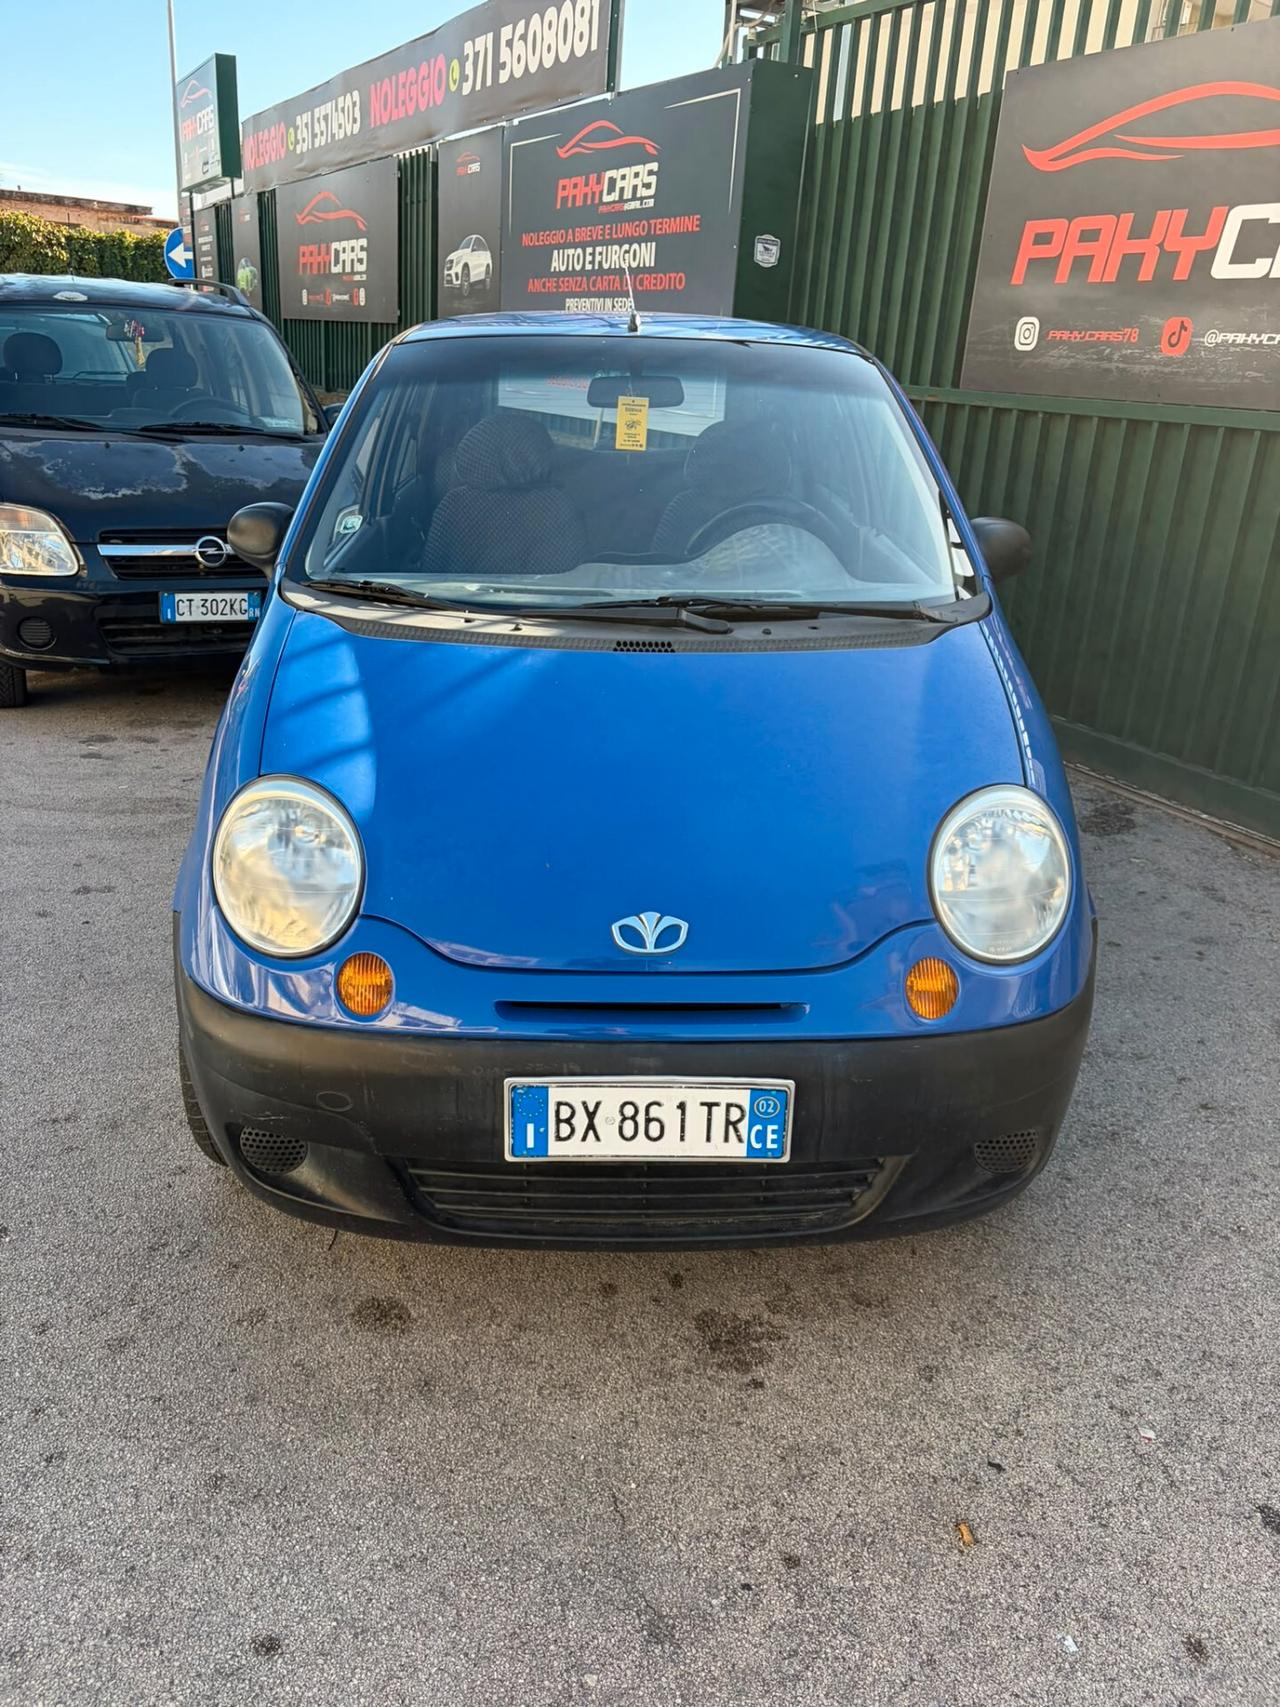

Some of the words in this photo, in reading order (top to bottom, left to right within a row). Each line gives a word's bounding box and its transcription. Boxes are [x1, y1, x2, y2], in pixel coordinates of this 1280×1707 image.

[244, 121, 287, 170] NOLEGGIO
[295, 113, 311, 154] 351
[314, 90, 361, 147] 5574503
[370, 54, 447, 128] NOLEGGIO
[462, 32, 493, 96] 371
[498, 0, 600, 84] 5608081
[522, 232, 566, 247] NOLEGGIO
[566, 231, 574, 242] A
[575, 225, 604, 242] BREVE
[605, 225, 611, 239] E
[612, 220, 648, 238] LUNGO
[649, 215, 701, 235] TERMINE
[1010, 203, 1280, 285] PAKYC
[550, 247, 584, 272] AUTO
[585, 247, 593, 270] E
[594, 242, 656, 269] FURGONI
[527, 277, 557, 292] ANCHE
[558, 275, 588, 292] SENZA
[589, 274, 621, 292] CARTA
[636, 272, 686, 291] CREDITO
[565, 298, 605, 313] PREVENTIVI
[605, 298, 613, 312] IN
[613, 297, 634, 312] SEDE
[177, 598, 194, 616] CT
[200, 598, 248, 616] 302KG
[757, 1101, 776, 1114] 02
[526, 1123, 535, 1148] I
[554, 1100, 602, 1142] BX
[750, 1124, 779, 1150] CE
